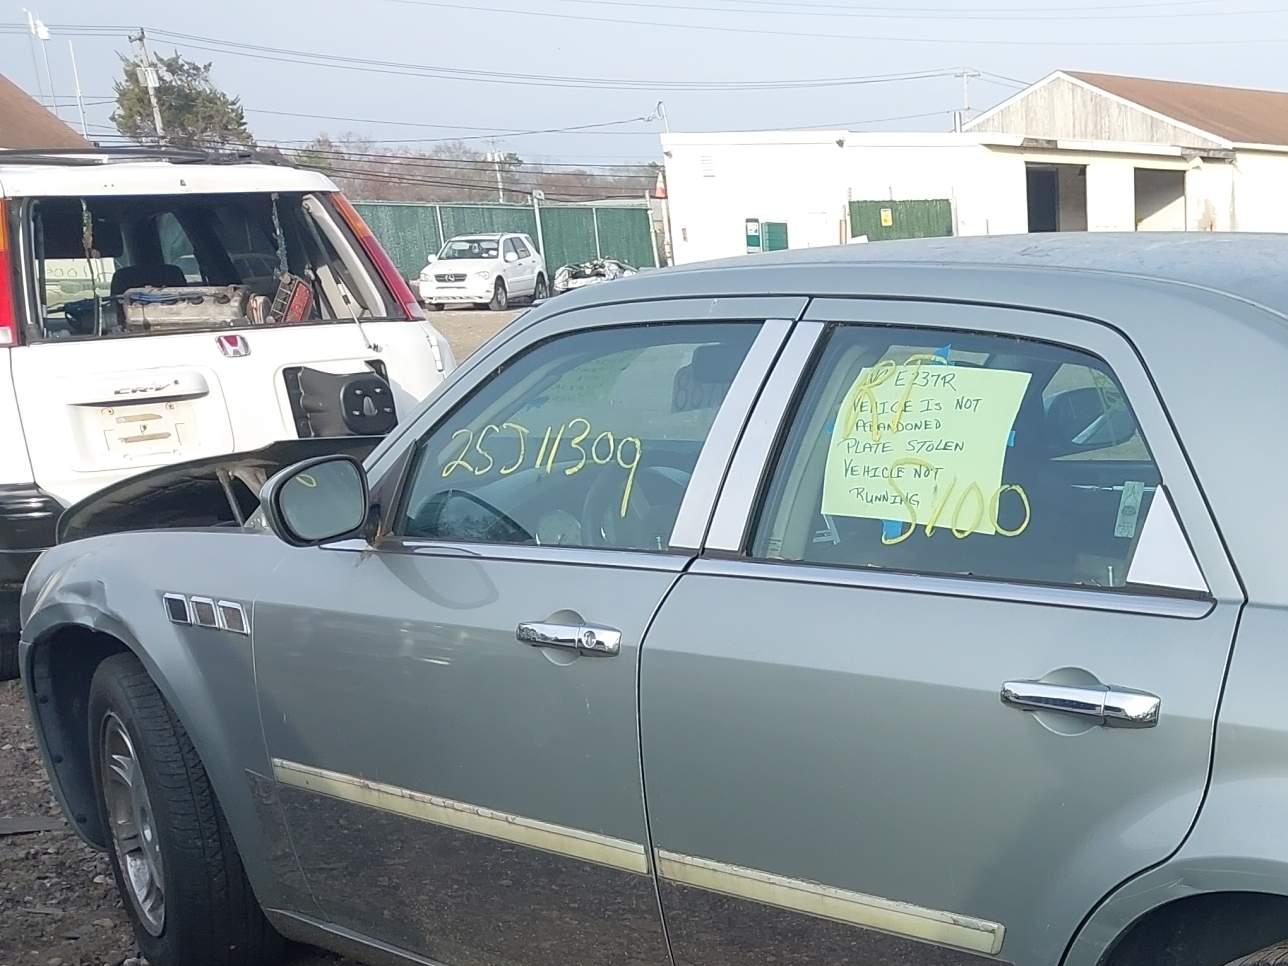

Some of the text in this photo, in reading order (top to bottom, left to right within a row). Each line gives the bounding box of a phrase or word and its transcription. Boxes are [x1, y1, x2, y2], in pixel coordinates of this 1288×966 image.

[954, 396, 984, 412] NOT
[855, 418, 942, 433] ABANDONED
[837, 437, 966, 455] PLATE STOLEN
[843, 458, 944, 481] VEHICLE NOT
[848, 486, 921, 508] RUNNING
